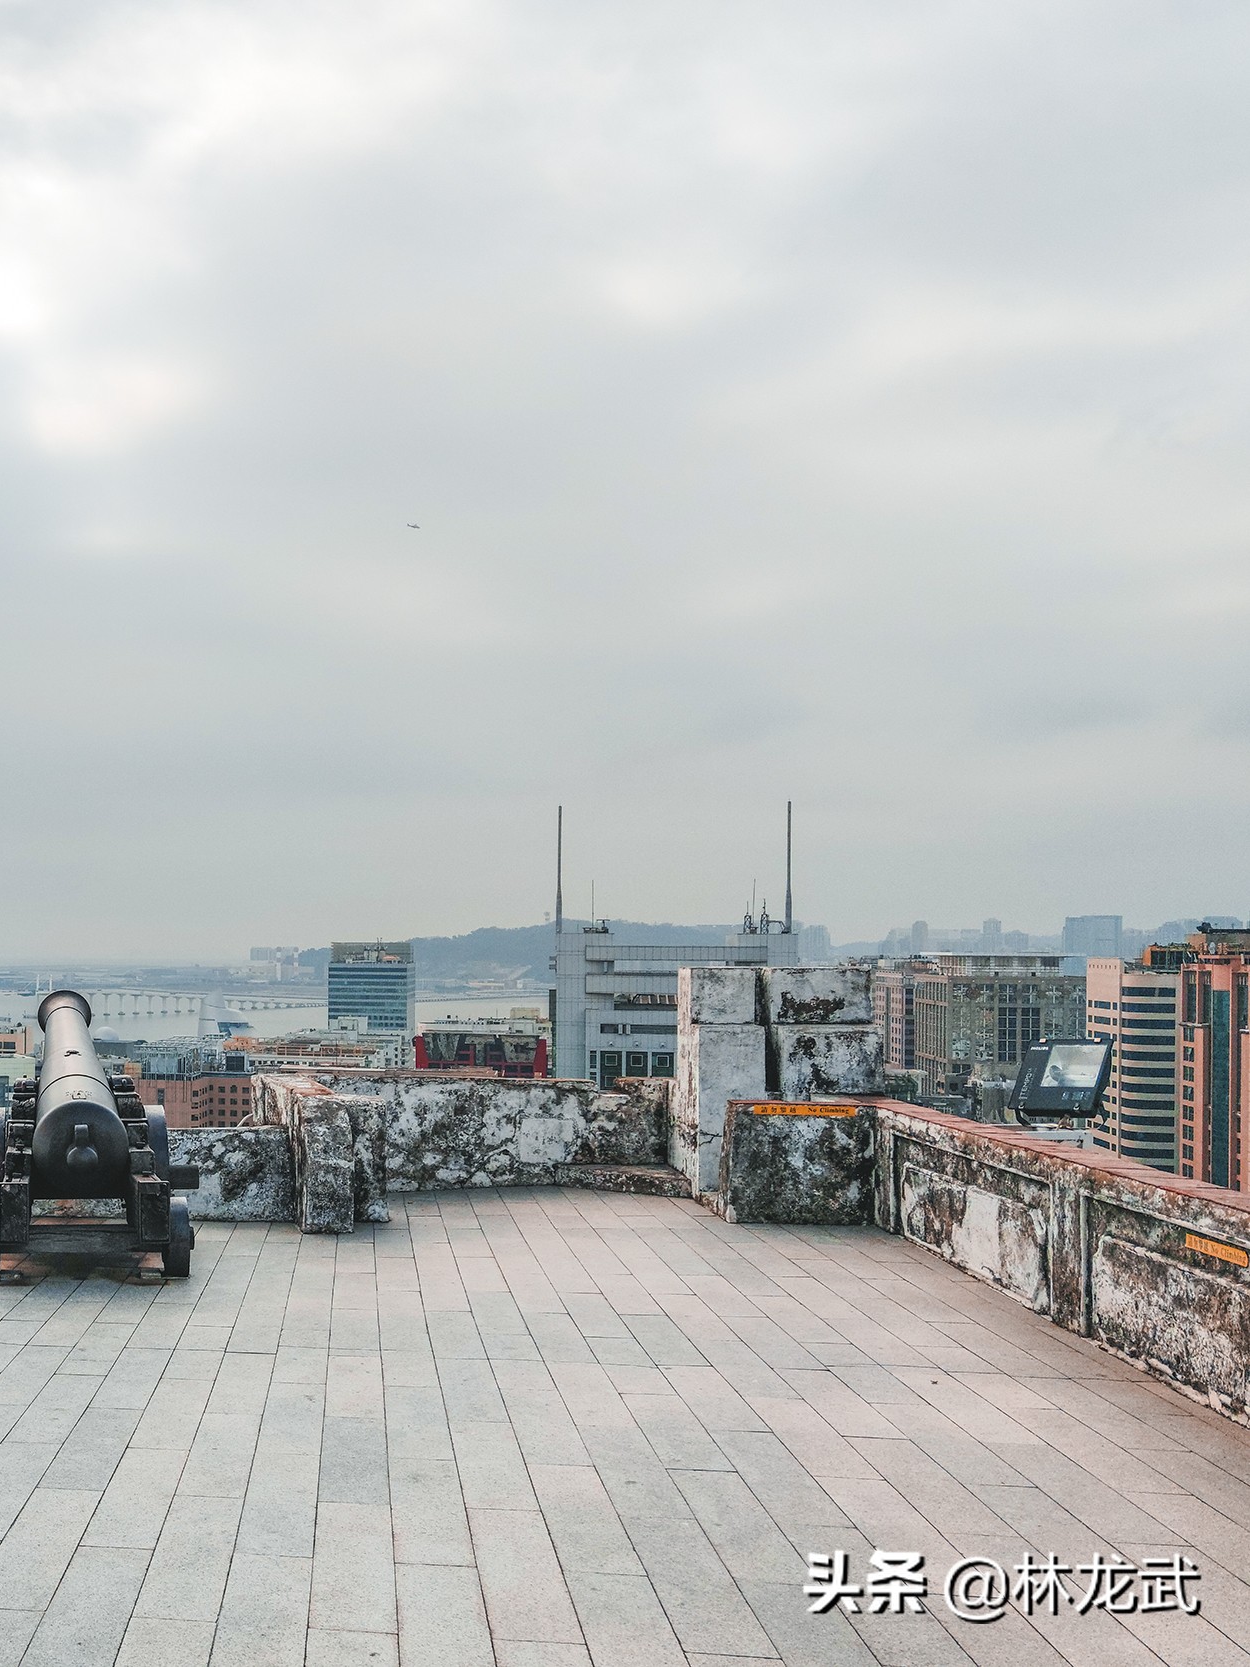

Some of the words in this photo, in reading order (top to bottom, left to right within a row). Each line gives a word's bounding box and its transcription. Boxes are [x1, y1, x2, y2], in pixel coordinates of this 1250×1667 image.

[819, 1107, 849, 1115] Climbing
[1210, 1243, 1219, 1255] No
[1221, 1247, 1247, 1266] Climbing
